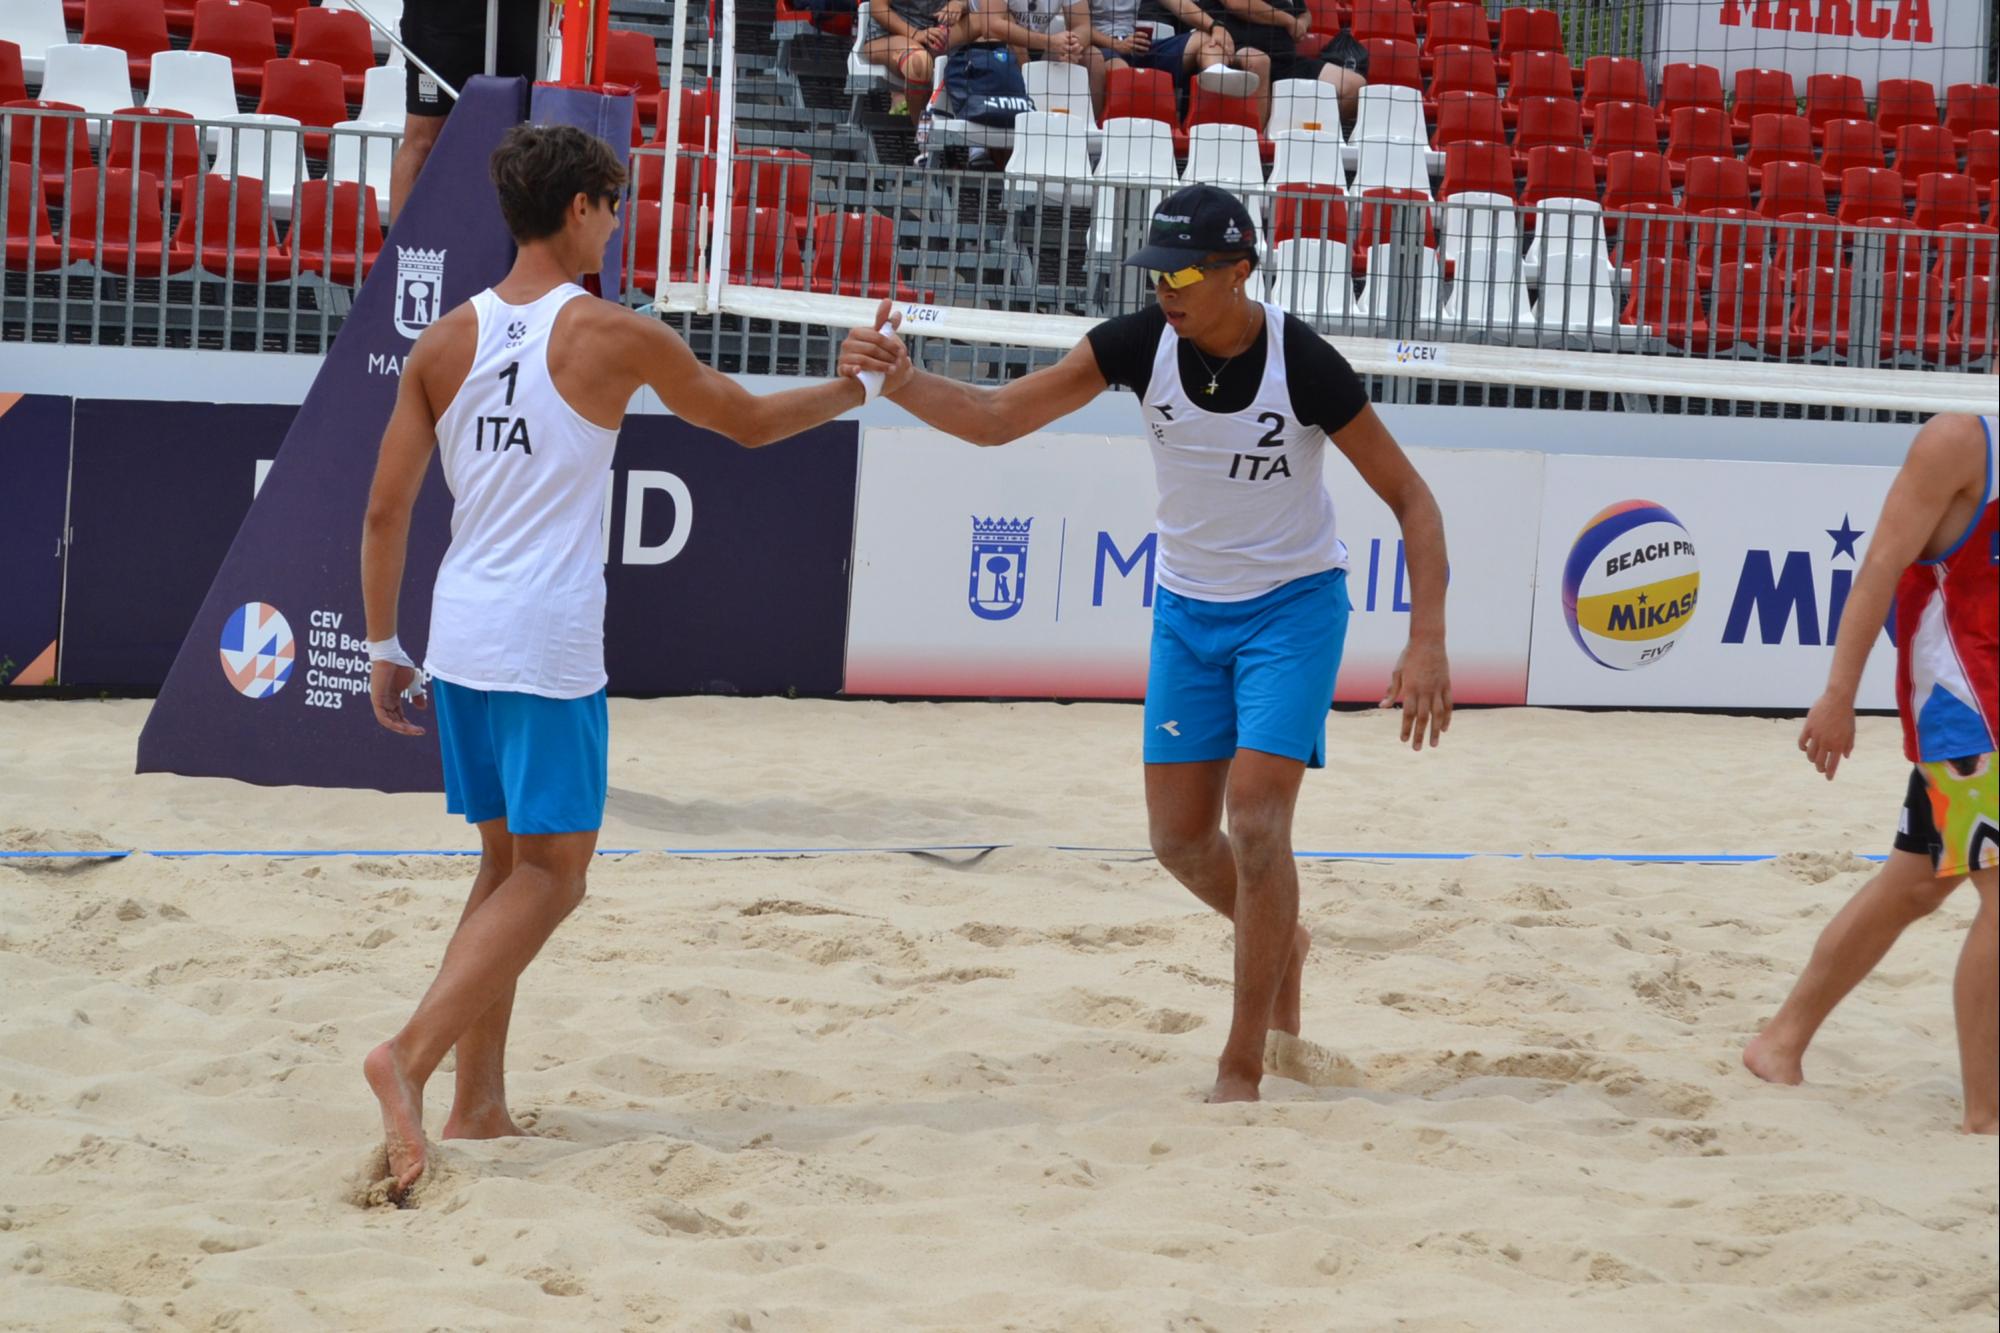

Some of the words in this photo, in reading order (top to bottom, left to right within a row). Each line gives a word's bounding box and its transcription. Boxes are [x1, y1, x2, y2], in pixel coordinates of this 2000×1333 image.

[919, 309, 939, 321] CEV
[1413, 346, 1437, 360] CEV
[499, 361, 519, 406] 1
[476, 416, 532, 455] ITA
[1257, 412, 1285, 447] 2
[1229, 453, 1291, 480] ITA
[1606, 542, 1669, 577] BEACH
[310, 610, 342, 629] CEV
[309, 630, 336, 648] U18
[340, 634, 368, 653] Bea
[305, 689, 342, 709] 2023
